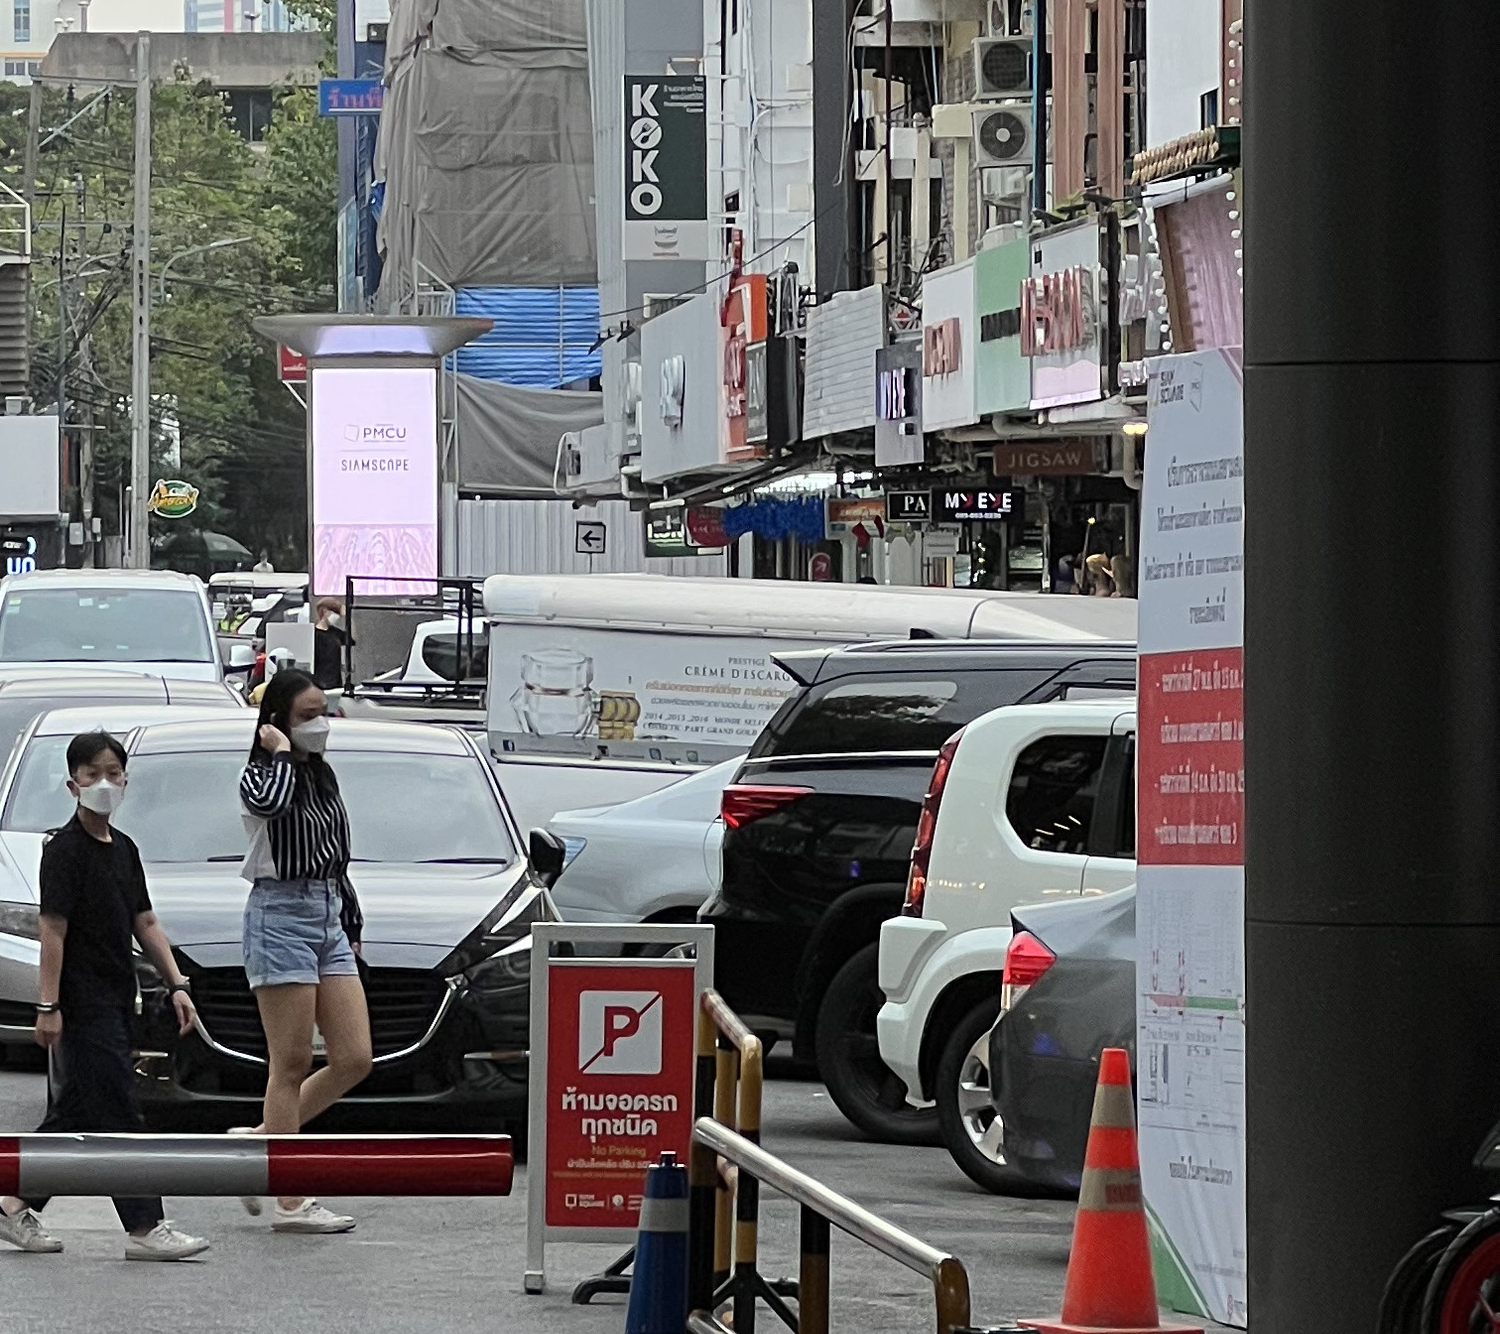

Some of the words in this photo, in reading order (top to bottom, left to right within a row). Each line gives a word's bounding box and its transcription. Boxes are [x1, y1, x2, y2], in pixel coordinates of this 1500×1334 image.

[363, 427, 406, 439] PMCU
[1008, 452, 1082, 467] JIGSAW
[977, 492, 1012, 510] EYE
[561, 1086, 678, 1112] ห้ามจอดรถ
[581, 1114, 658, 1144] ทุกชนิด
[591, 1145, 607, 1156] No
[609, 1145, 647, 1158] Parking
